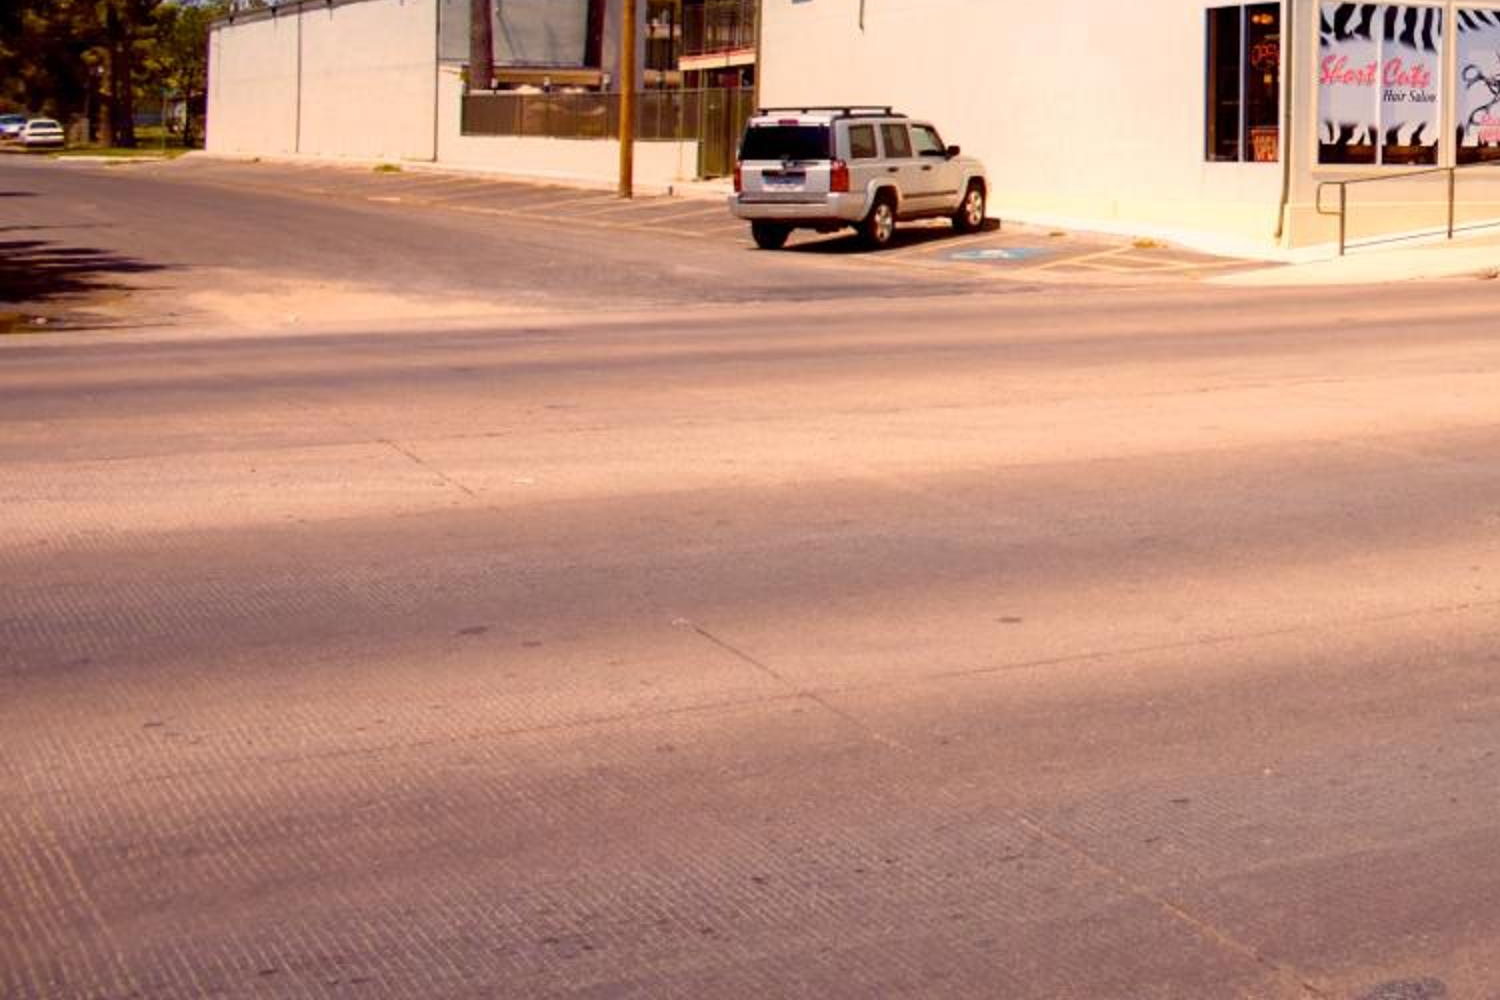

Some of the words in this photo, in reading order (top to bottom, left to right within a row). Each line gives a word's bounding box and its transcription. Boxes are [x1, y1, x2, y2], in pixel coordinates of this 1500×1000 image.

[1318, 55, 1377, 86] Short
[1382, 56, 1431, 87] Cuts
[1383, 88, 1406, 102] Hair
[1408, 89, 1437, 103] Salon
